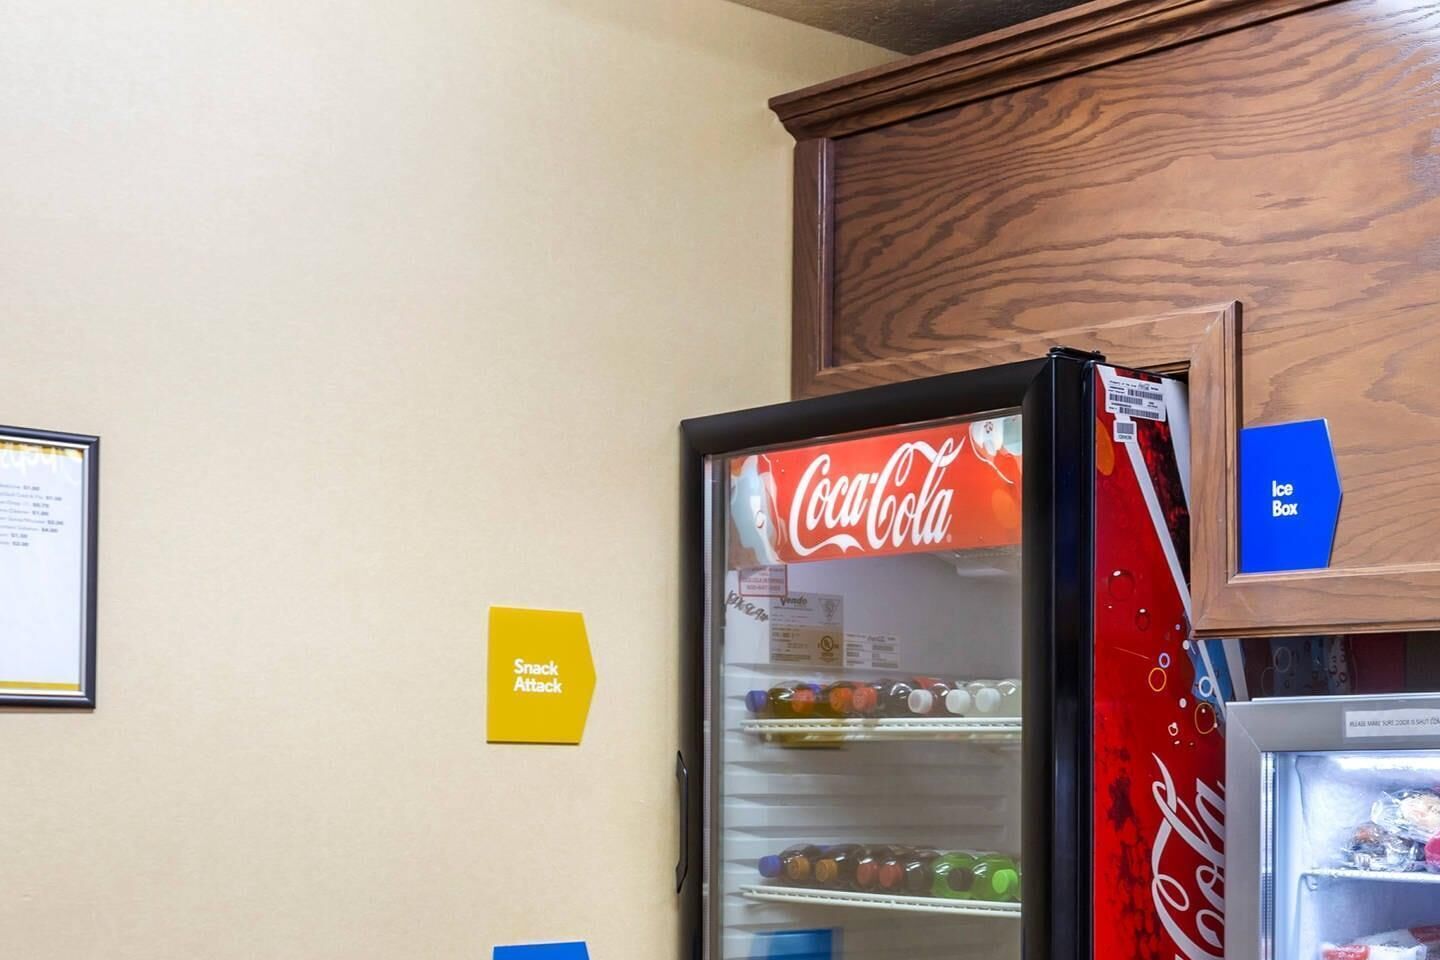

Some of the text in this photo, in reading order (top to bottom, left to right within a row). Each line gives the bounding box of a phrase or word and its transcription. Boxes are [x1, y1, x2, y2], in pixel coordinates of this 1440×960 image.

[789, 436, 966, 556] Coca-Cola
[1272, 480, 1294, 497] Ice
[1272, 500, 1298, 517] Box
[513, 658, 559, 676] Snack
[513, 676, 562, 693] Attack
